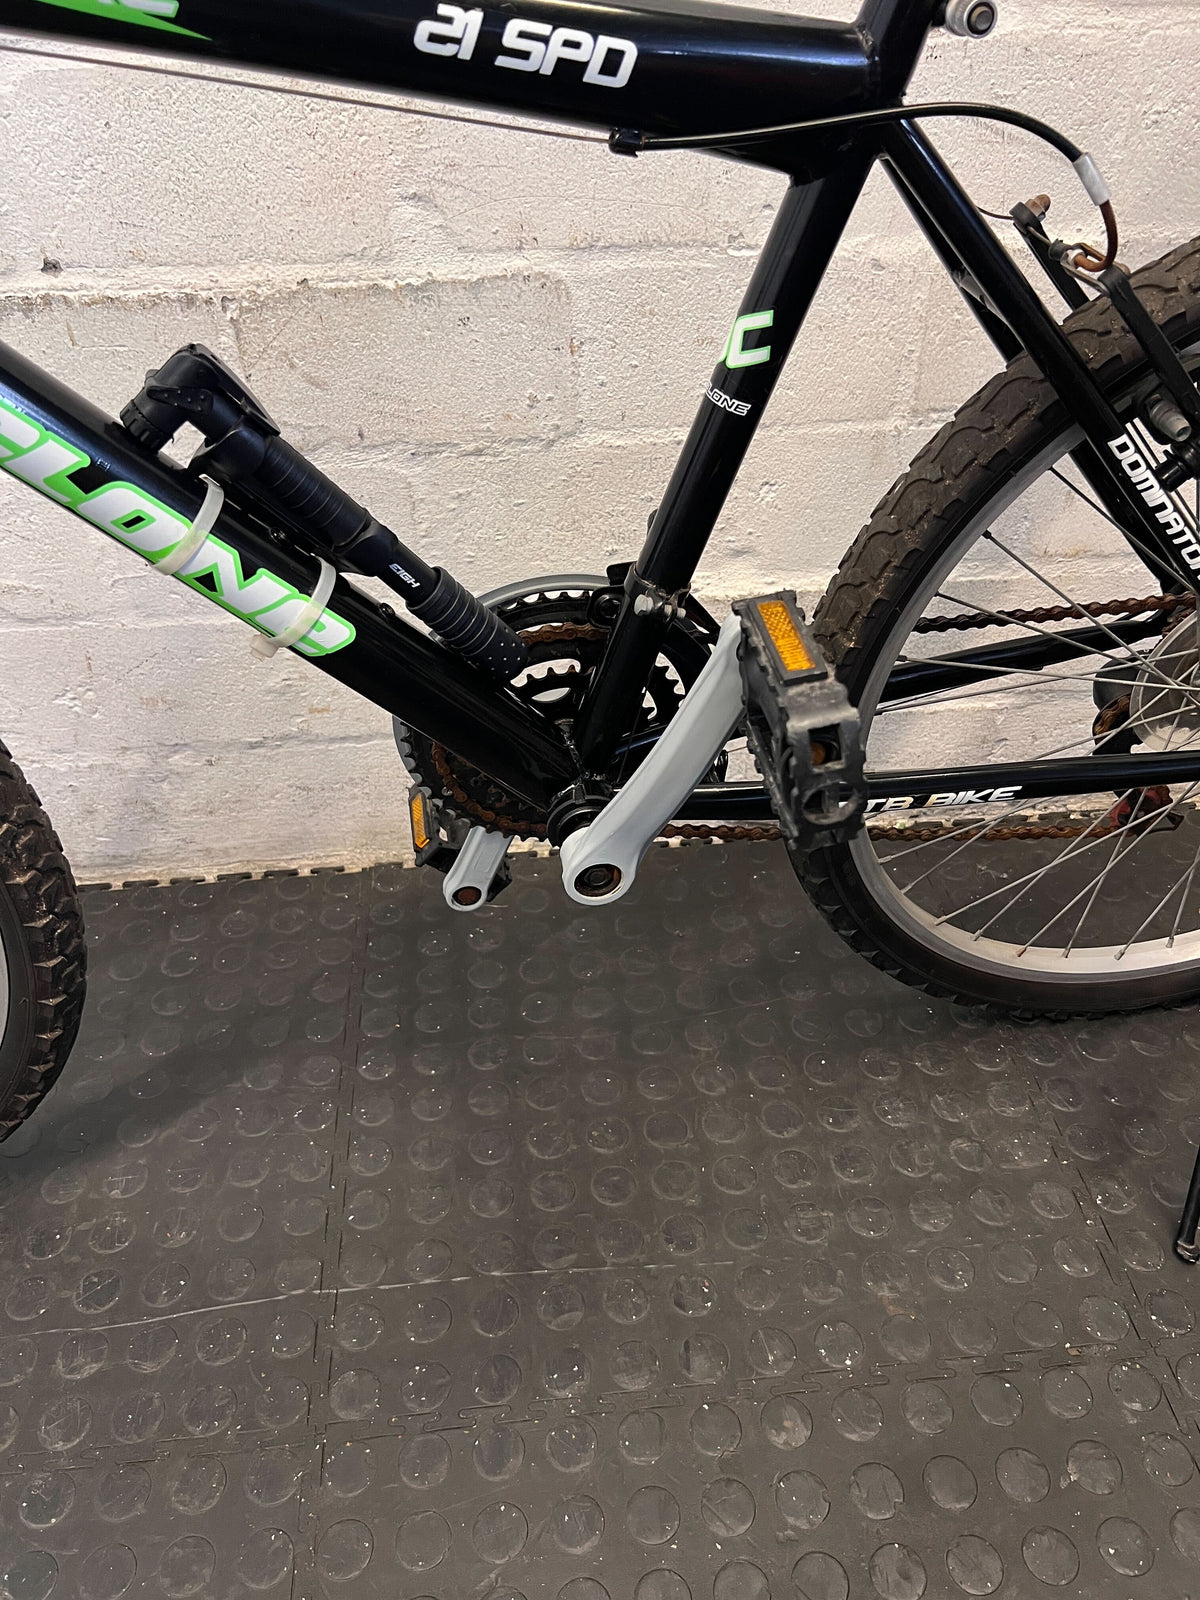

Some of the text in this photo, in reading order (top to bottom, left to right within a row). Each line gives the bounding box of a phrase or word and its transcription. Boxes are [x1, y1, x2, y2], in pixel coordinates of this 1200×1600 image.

[413, 3, 639, 89] 21 SPD
[1107, 433, 1200, 582] DOMINATO
[838, 785, 1023, 813] TB BIKE
